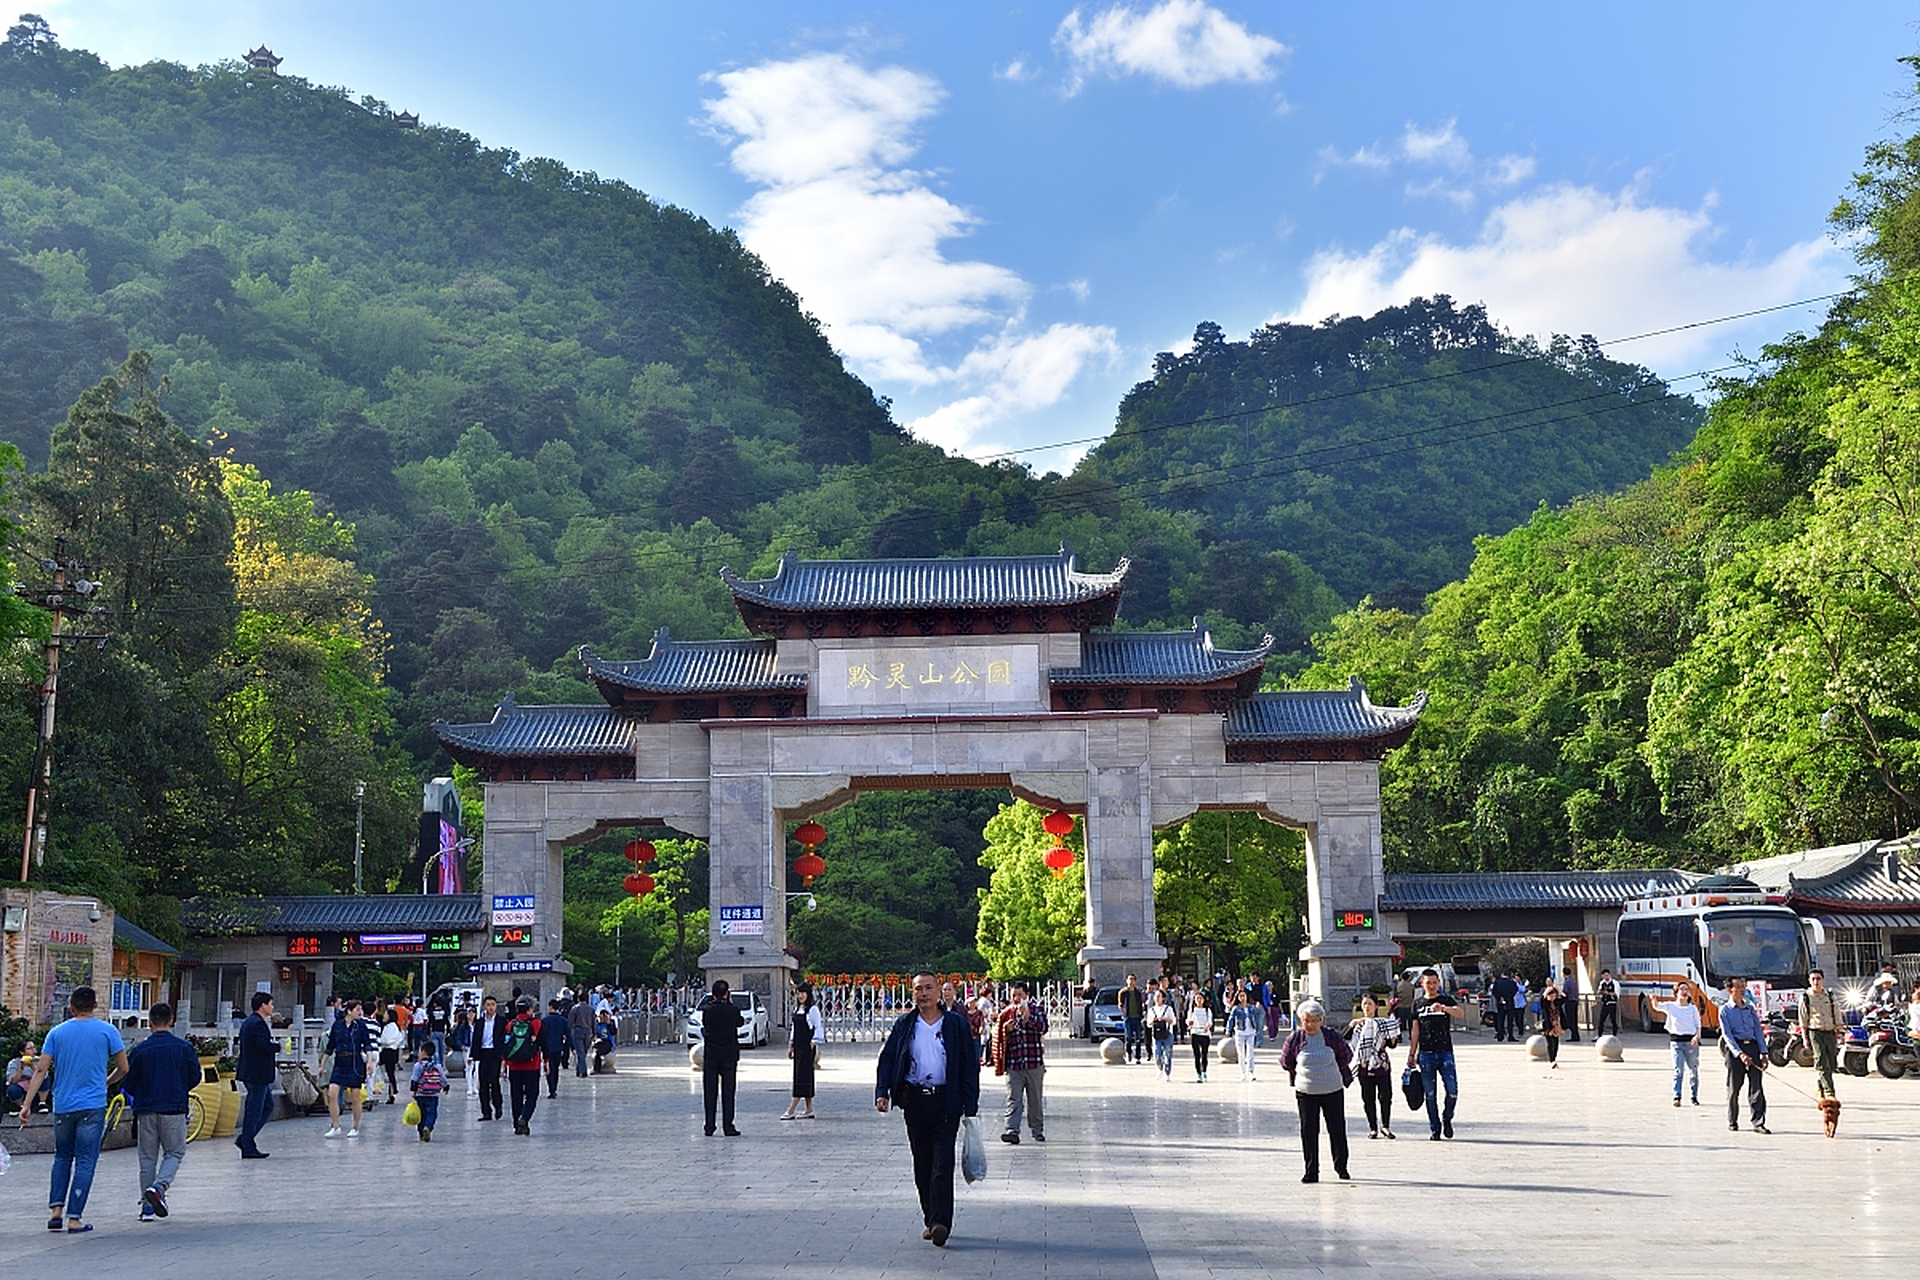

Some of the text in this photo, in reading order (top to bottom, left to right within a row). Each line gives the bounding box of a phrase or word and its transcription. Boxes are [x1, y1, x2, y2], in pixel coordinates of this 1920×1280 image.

[847, 660, 1012, 690] 黔灵山公园
[494, 897, 534, 909] 禁止入园
[1344, 912, 1364, 926] 出口
[503, 928, 523, 942] 入口
